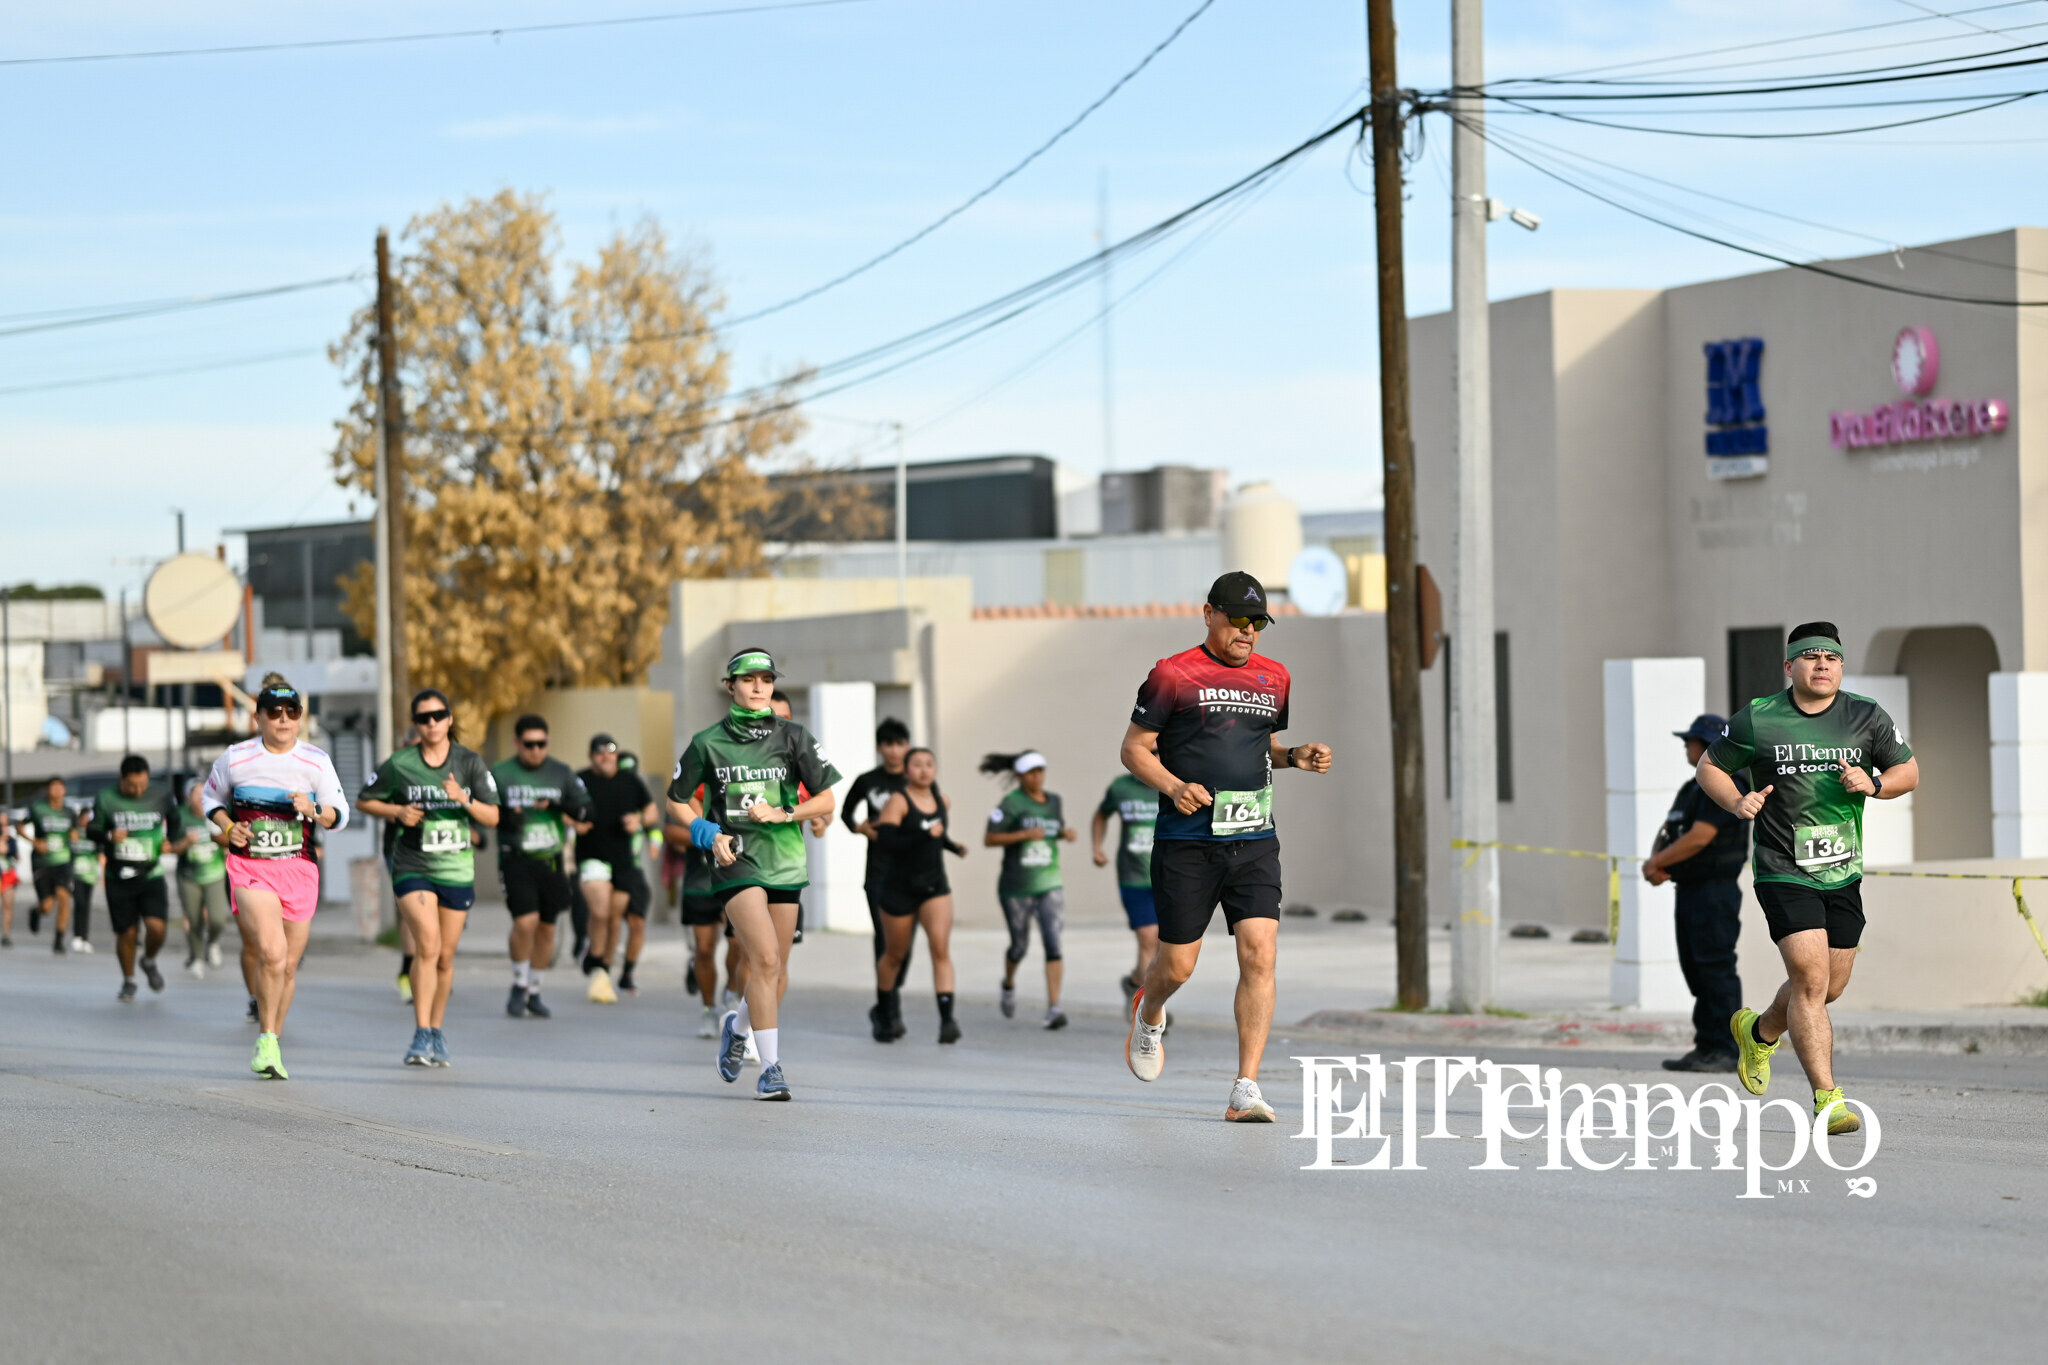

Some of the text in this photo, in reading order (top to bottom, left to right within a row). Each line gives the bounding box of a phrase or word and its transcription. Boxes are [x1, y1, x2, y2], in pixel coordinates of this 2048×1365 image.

[1198, 688, 1276, 707] IRONCAST
[1210, 705, 1272, 718] DE FRONTERA
[1773, 743, 1862, 763] El Tiempo
[715, 765, 787, 783] El Tiempo
[1776, 764, 1796, 776] de
[423, 784, 471, 800] Tieo
[740, 793, 768, 810] 66
[1223, 802, 1261, 822] 164
[257, 830, 293, 848] 301
[430, 829, 461, 845] 121
[1804, 836, 1846, 858] 136
